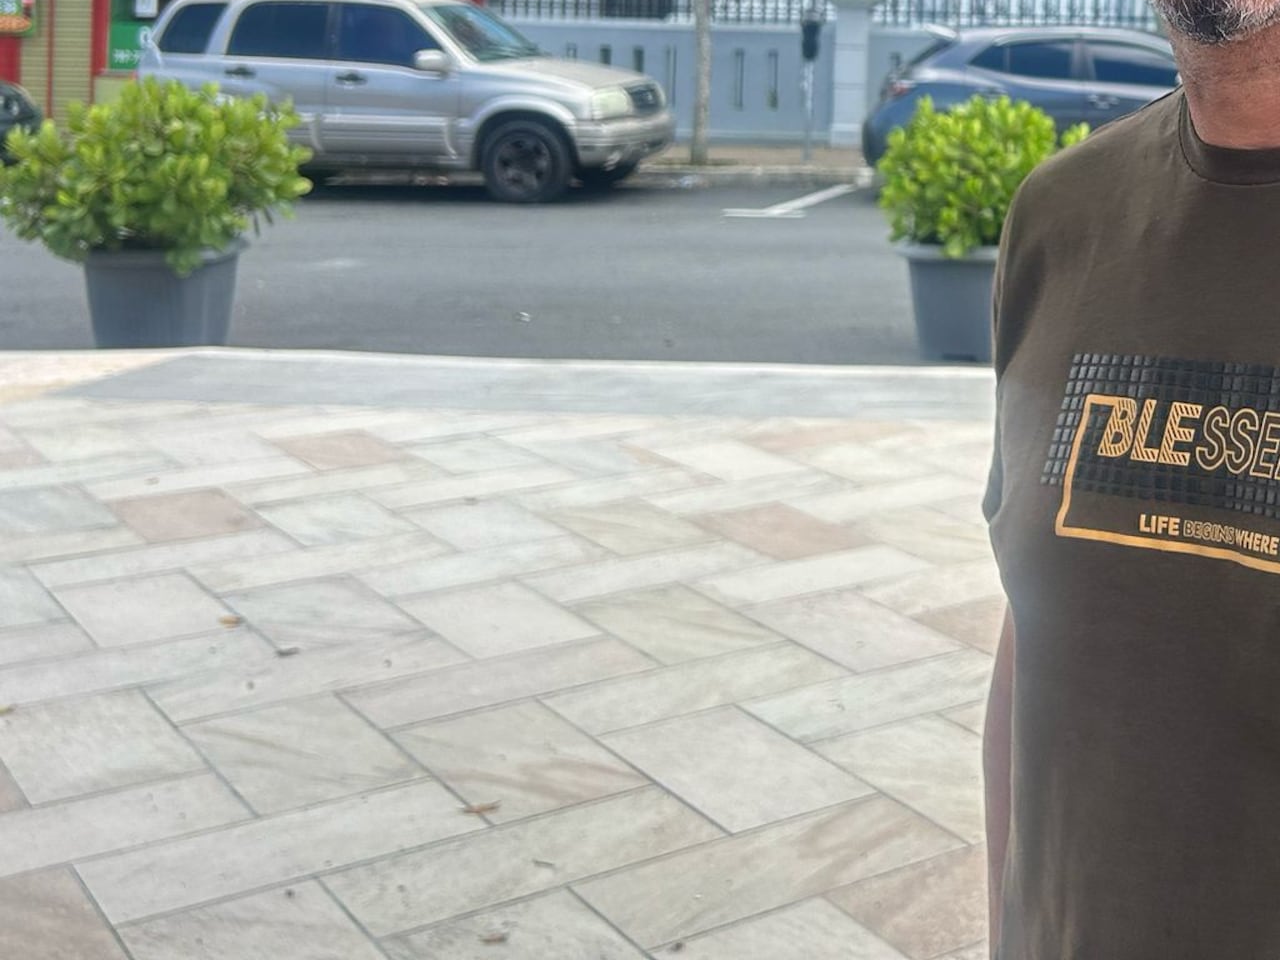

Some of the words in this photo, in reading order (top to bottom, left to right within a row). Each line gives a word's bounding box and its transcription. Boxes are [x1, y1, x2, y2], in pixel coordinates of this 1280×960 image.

[1139, 513, 1181, 536] LIFE
[1183, 519, 1235, 545] BEGINS
[1234, 528, 1280, 556] WHERE
